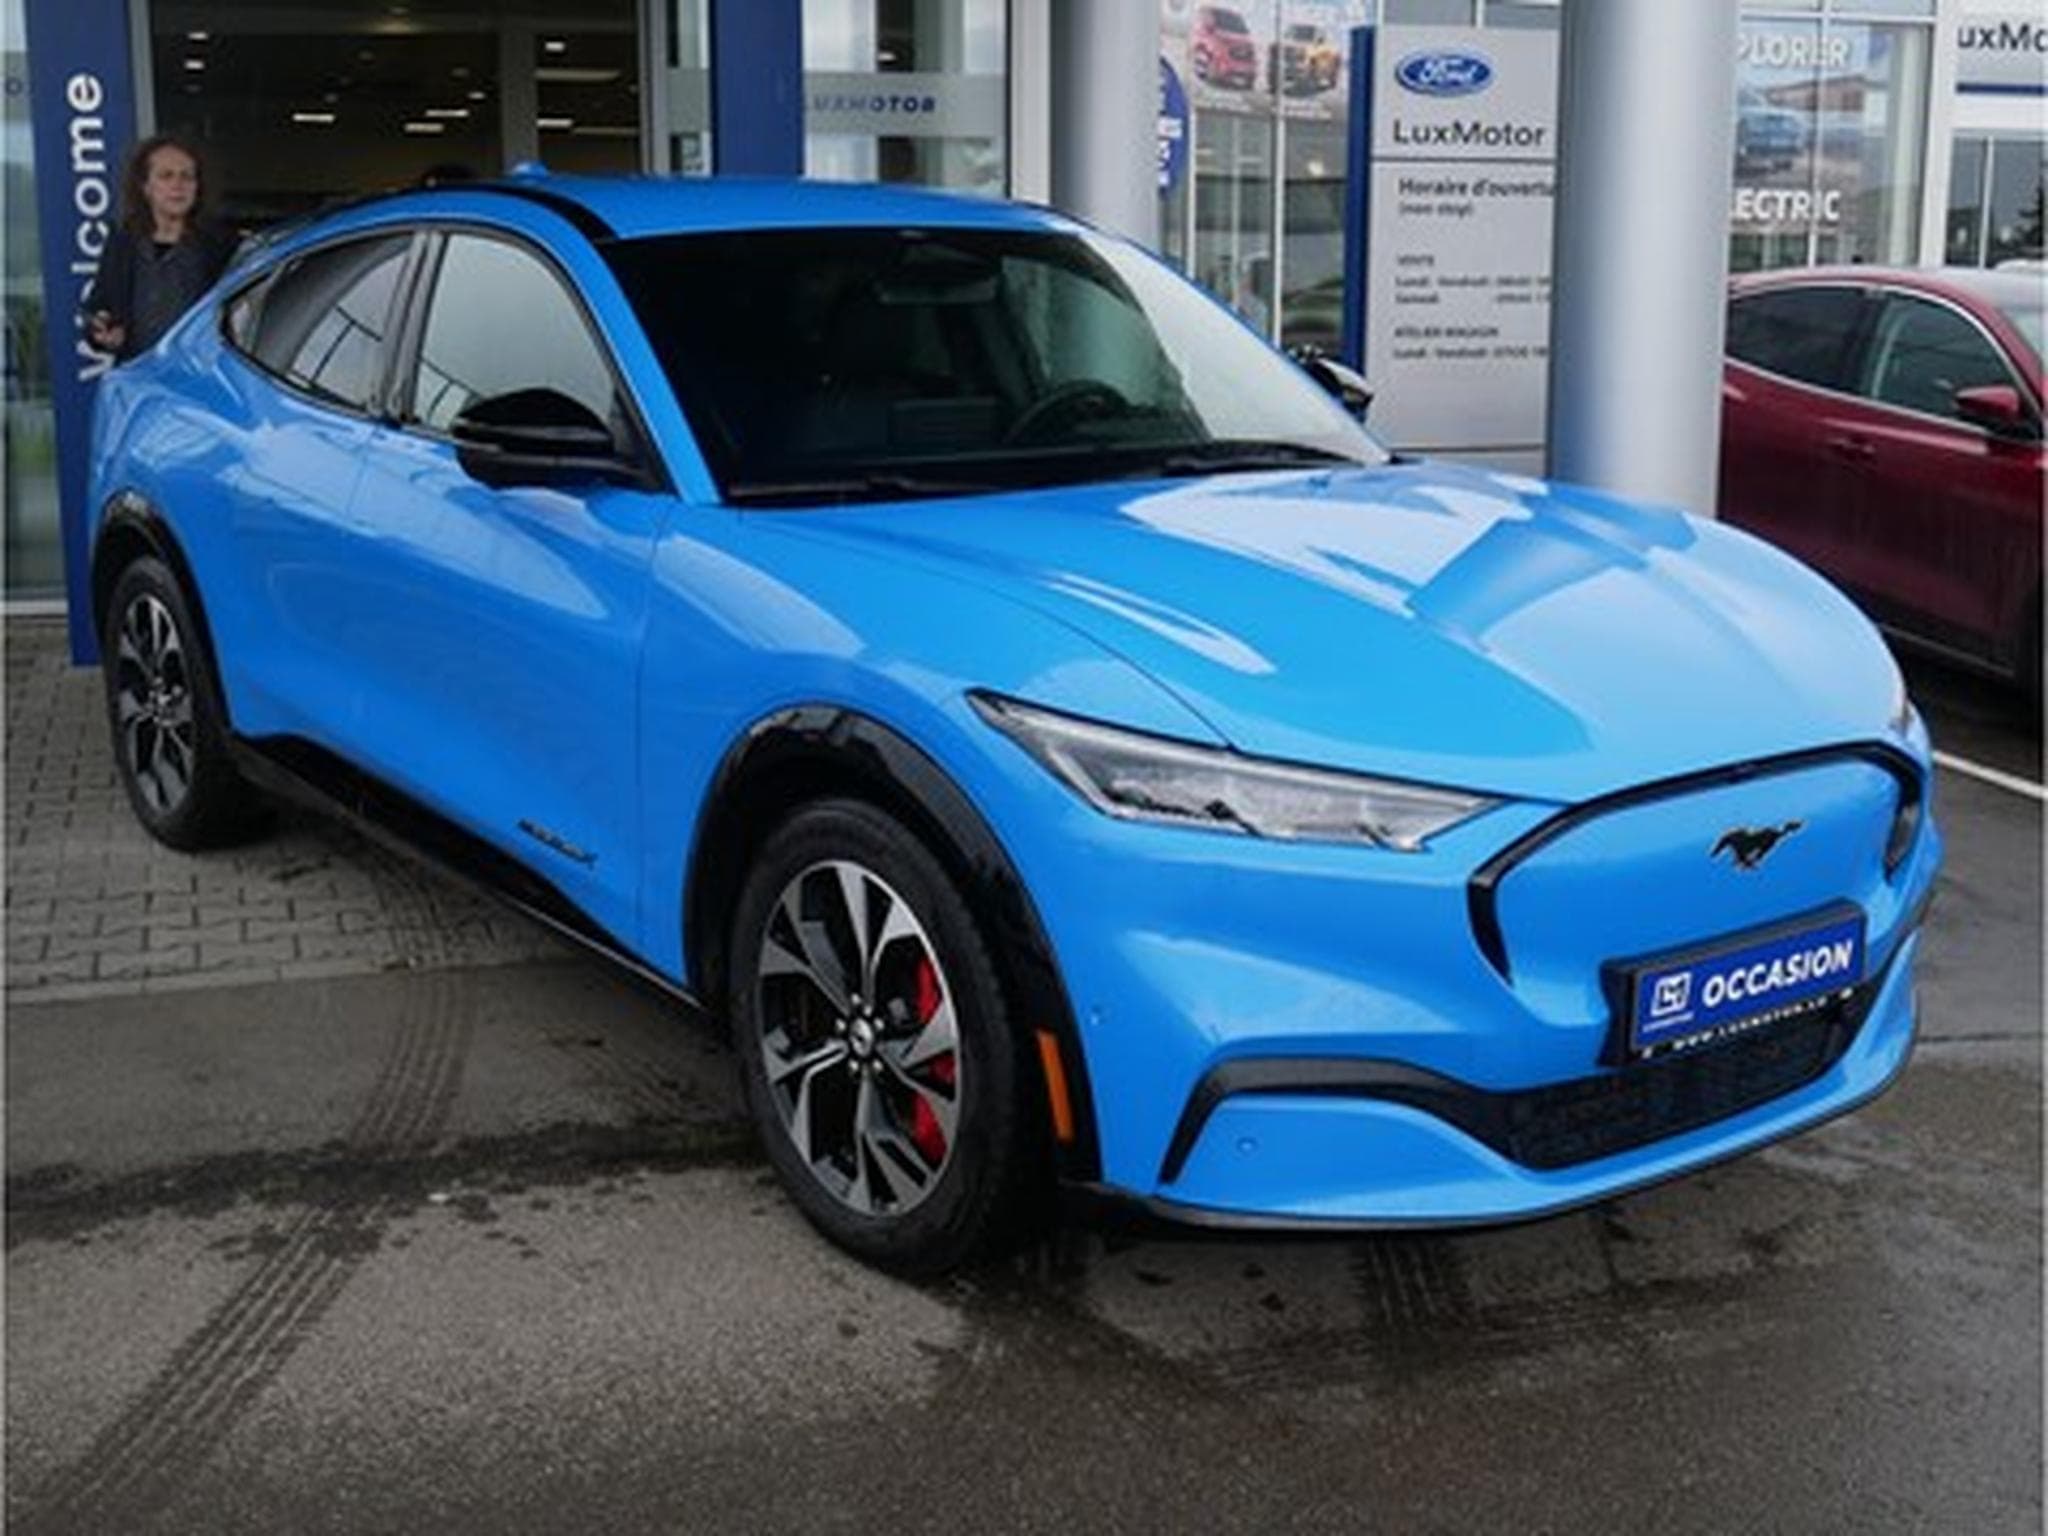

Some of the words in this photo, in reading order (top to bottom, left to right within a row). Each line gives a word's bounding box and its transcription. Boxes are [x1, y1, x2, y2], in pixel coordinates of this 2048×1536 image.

[1394, 119, 1546, 146] LuxMotor
[1399, 178, 1467, 195] Horaire
[1702, 938, 1852, 1008] OCCASION
